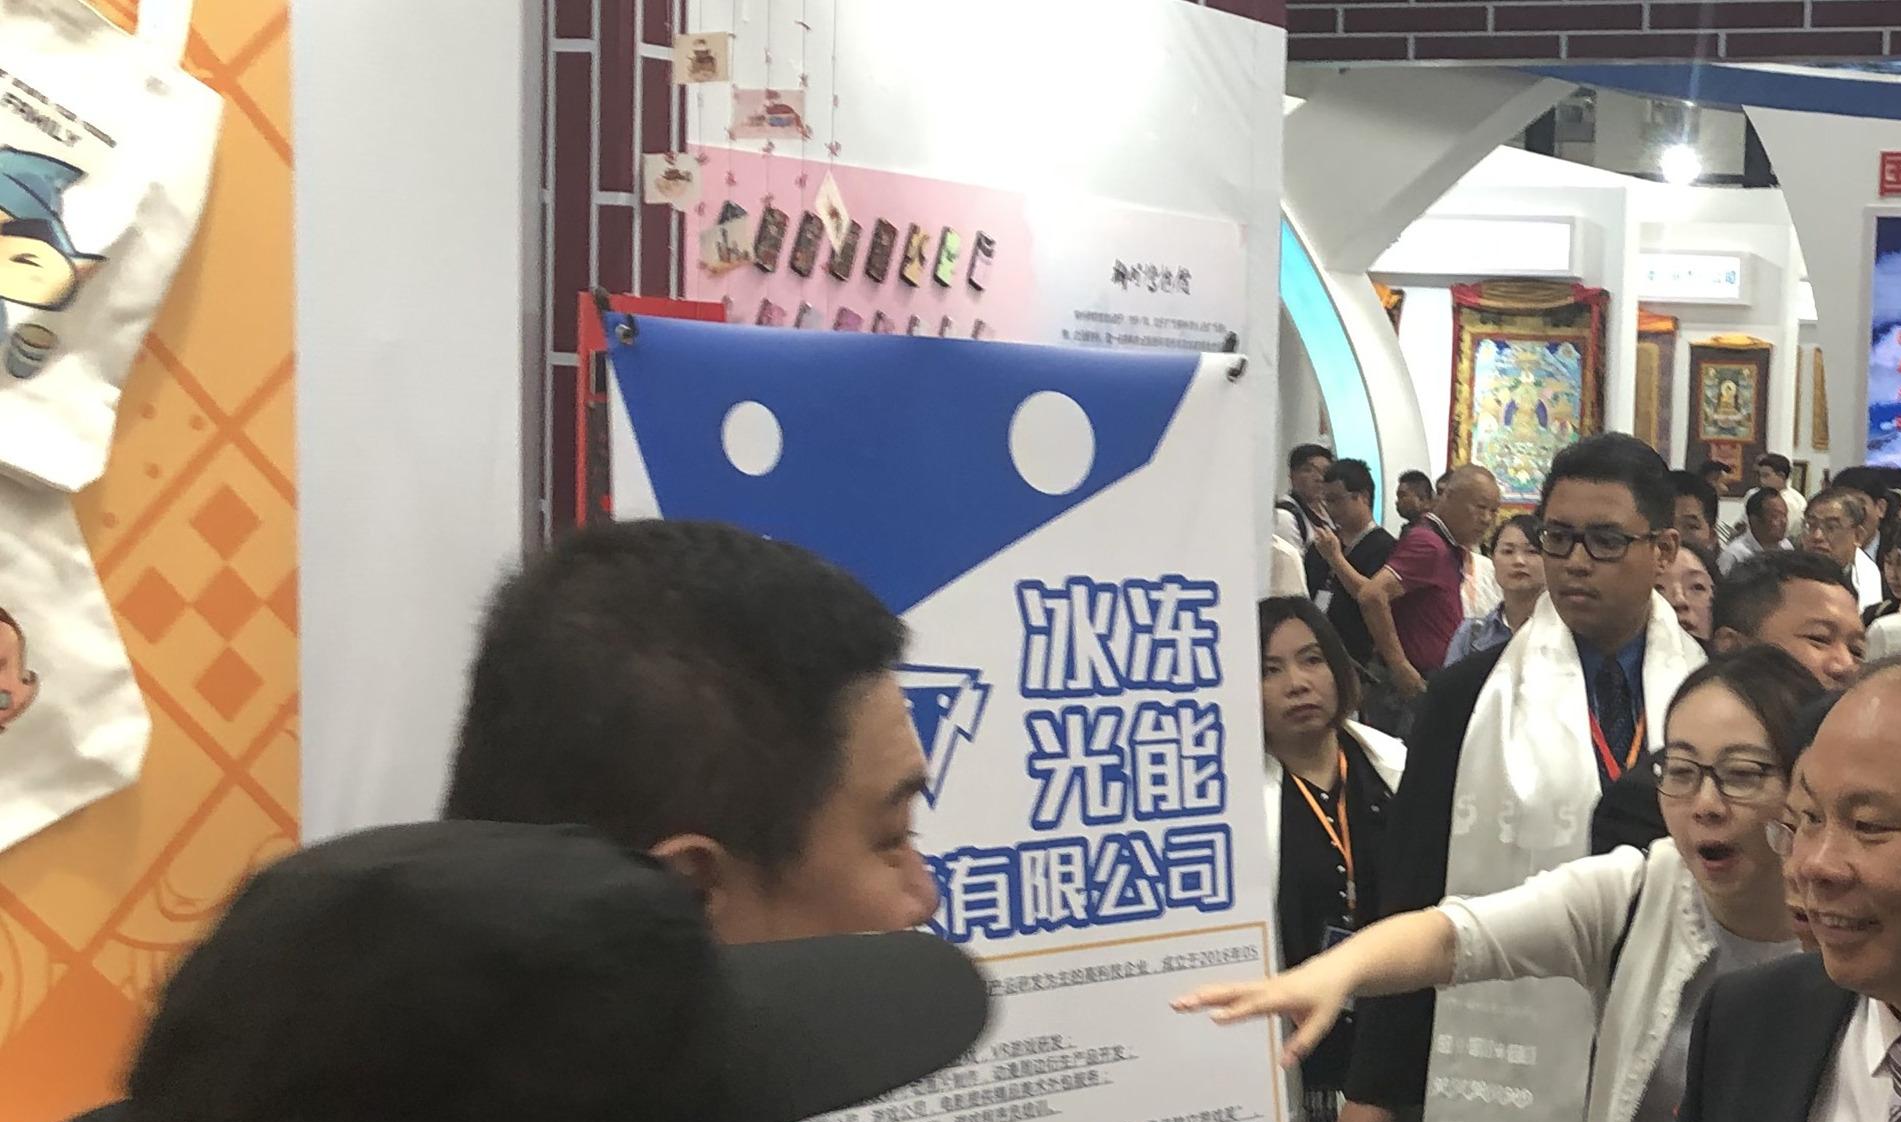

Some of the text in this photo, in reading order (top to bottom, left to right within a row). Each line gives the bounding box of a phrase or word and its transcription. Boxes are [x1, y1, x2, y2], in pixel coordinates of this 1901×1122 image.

[1014, 574, 1224, 699] 冰冻
[1024, 698, 1227, 831] 光能
[926, 822, 1236, 944] 有限公司
